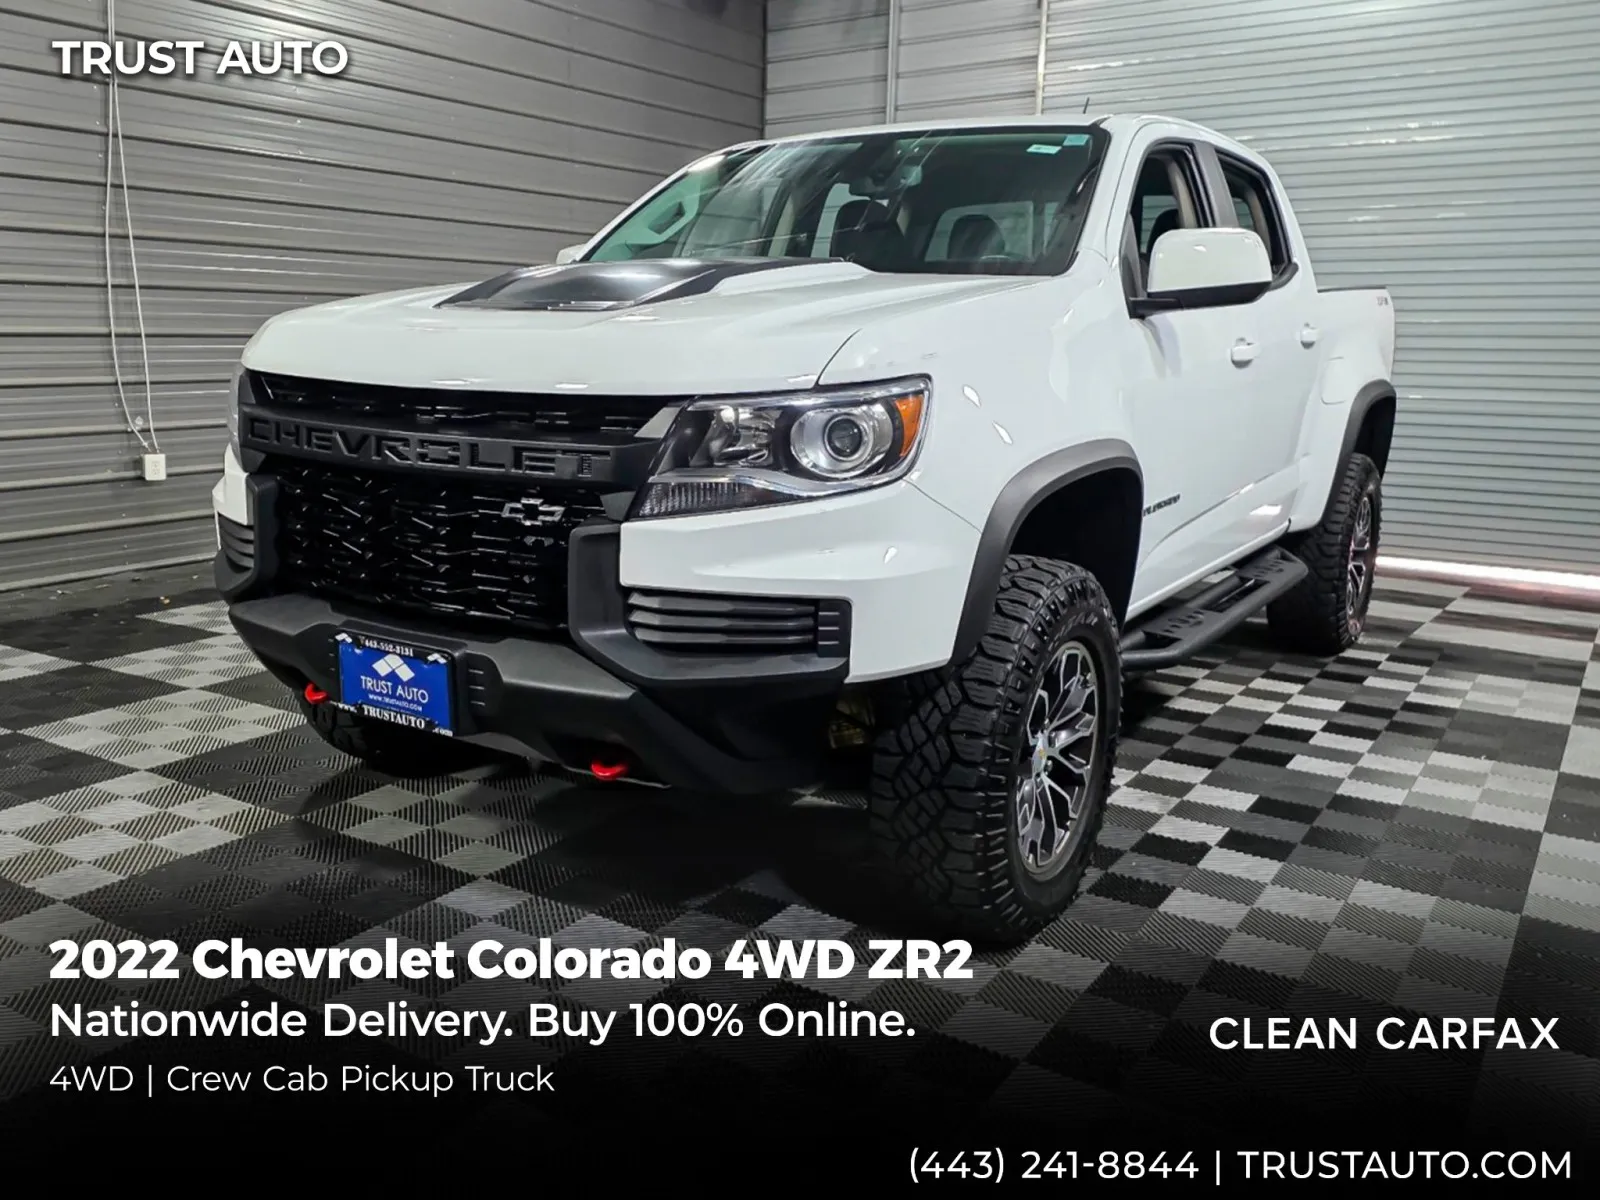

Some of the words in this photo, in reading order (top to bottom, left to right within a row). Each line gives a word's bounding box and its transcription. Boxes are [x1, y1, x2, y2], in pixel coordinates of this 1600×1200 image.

[247, 417, 612, 478] CHEVROLET
[360, 675, 393, 695] TRUST
[396, 685, 429, 704] AUTO
[361, 704, 426, 730] TRUSTAUTO
